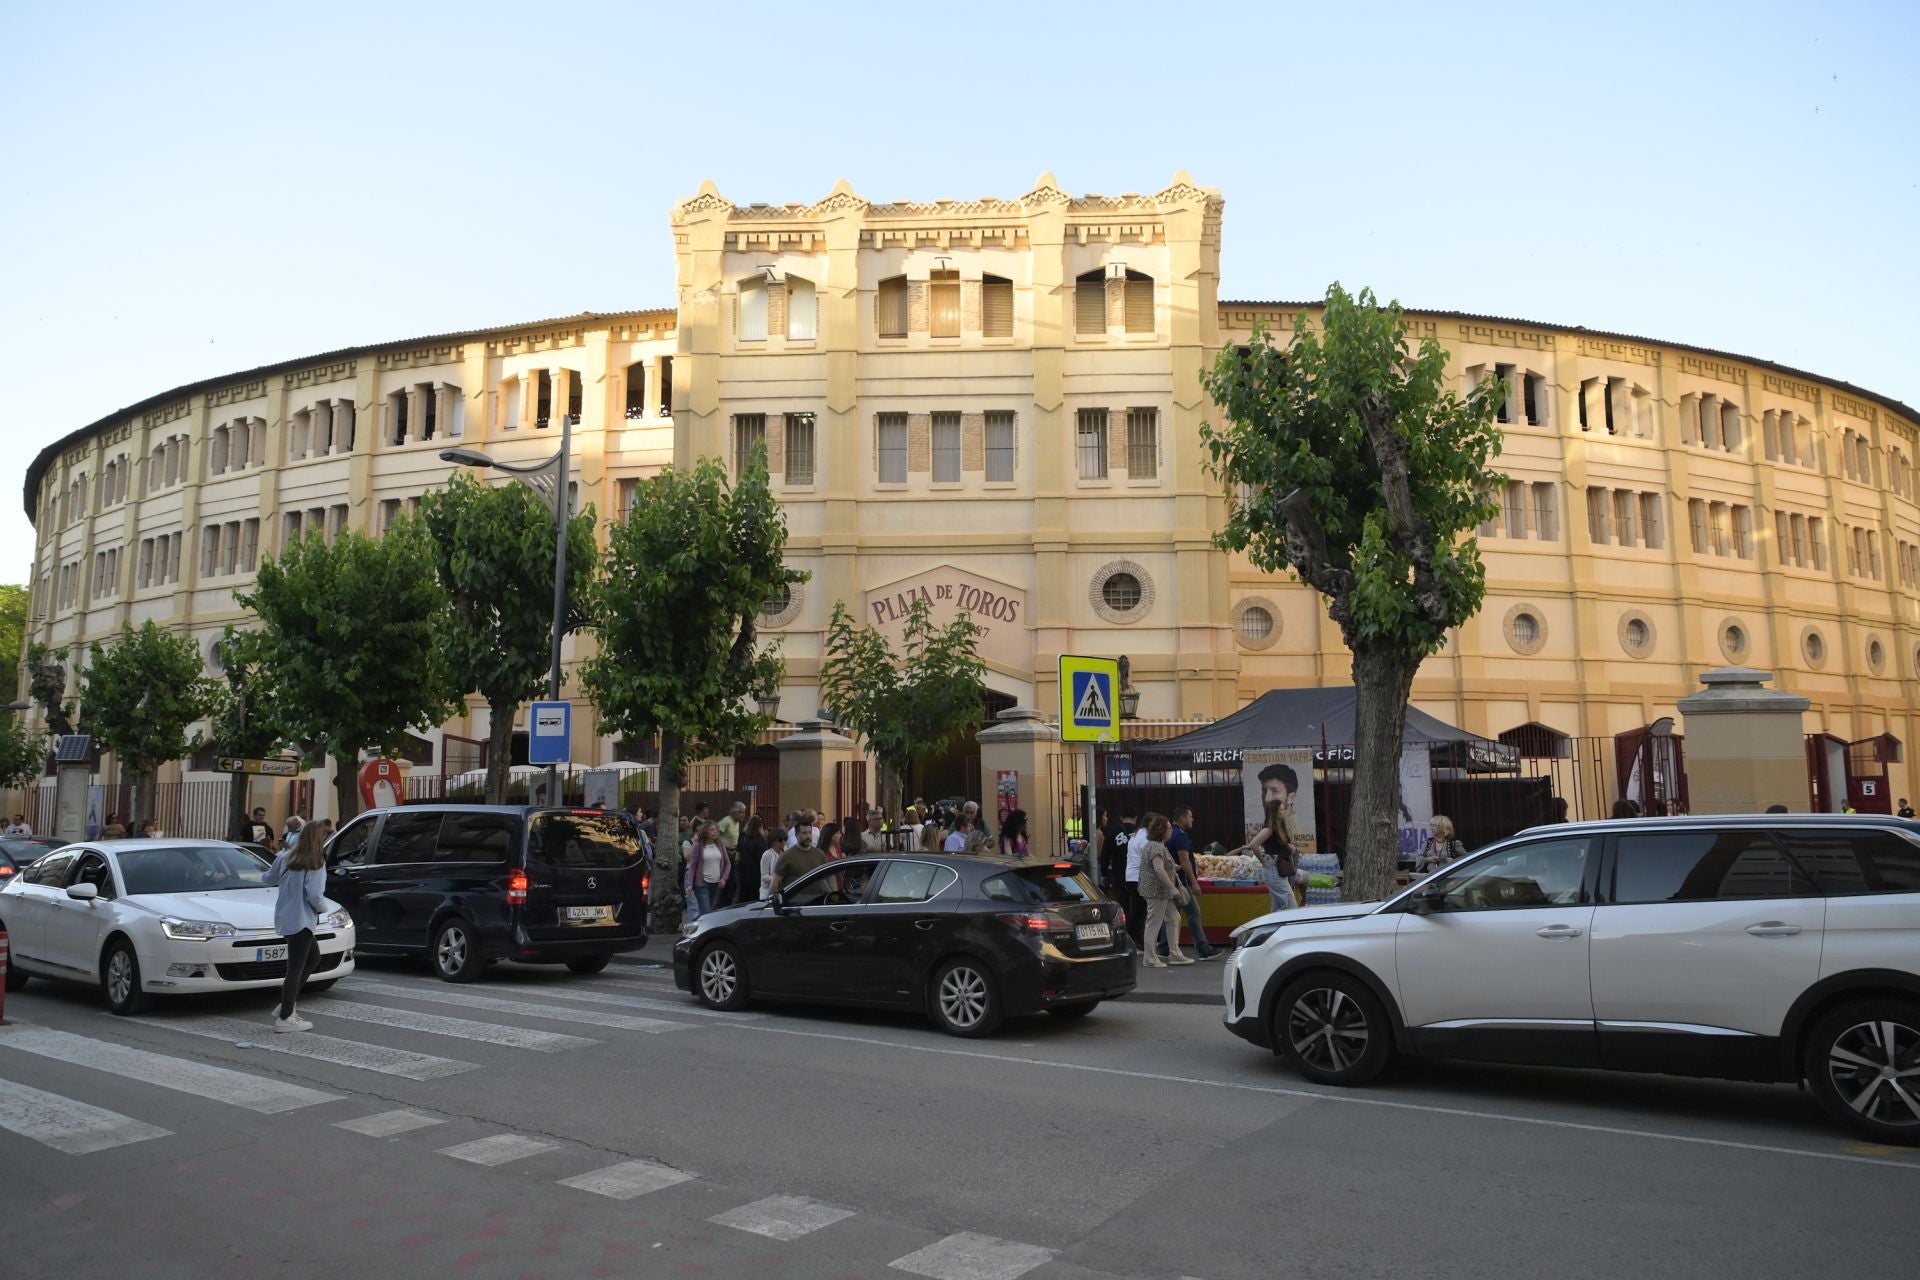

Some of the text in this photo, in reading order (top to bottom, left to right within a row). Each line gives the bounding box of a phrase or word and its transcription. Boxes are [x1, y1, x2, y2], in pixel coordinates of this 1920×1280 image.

[872, 584, 1020, 625] PLAZA DE TOROS
[233, 760, 243, 770] P
[1865, 785, 1873, 794] 5
